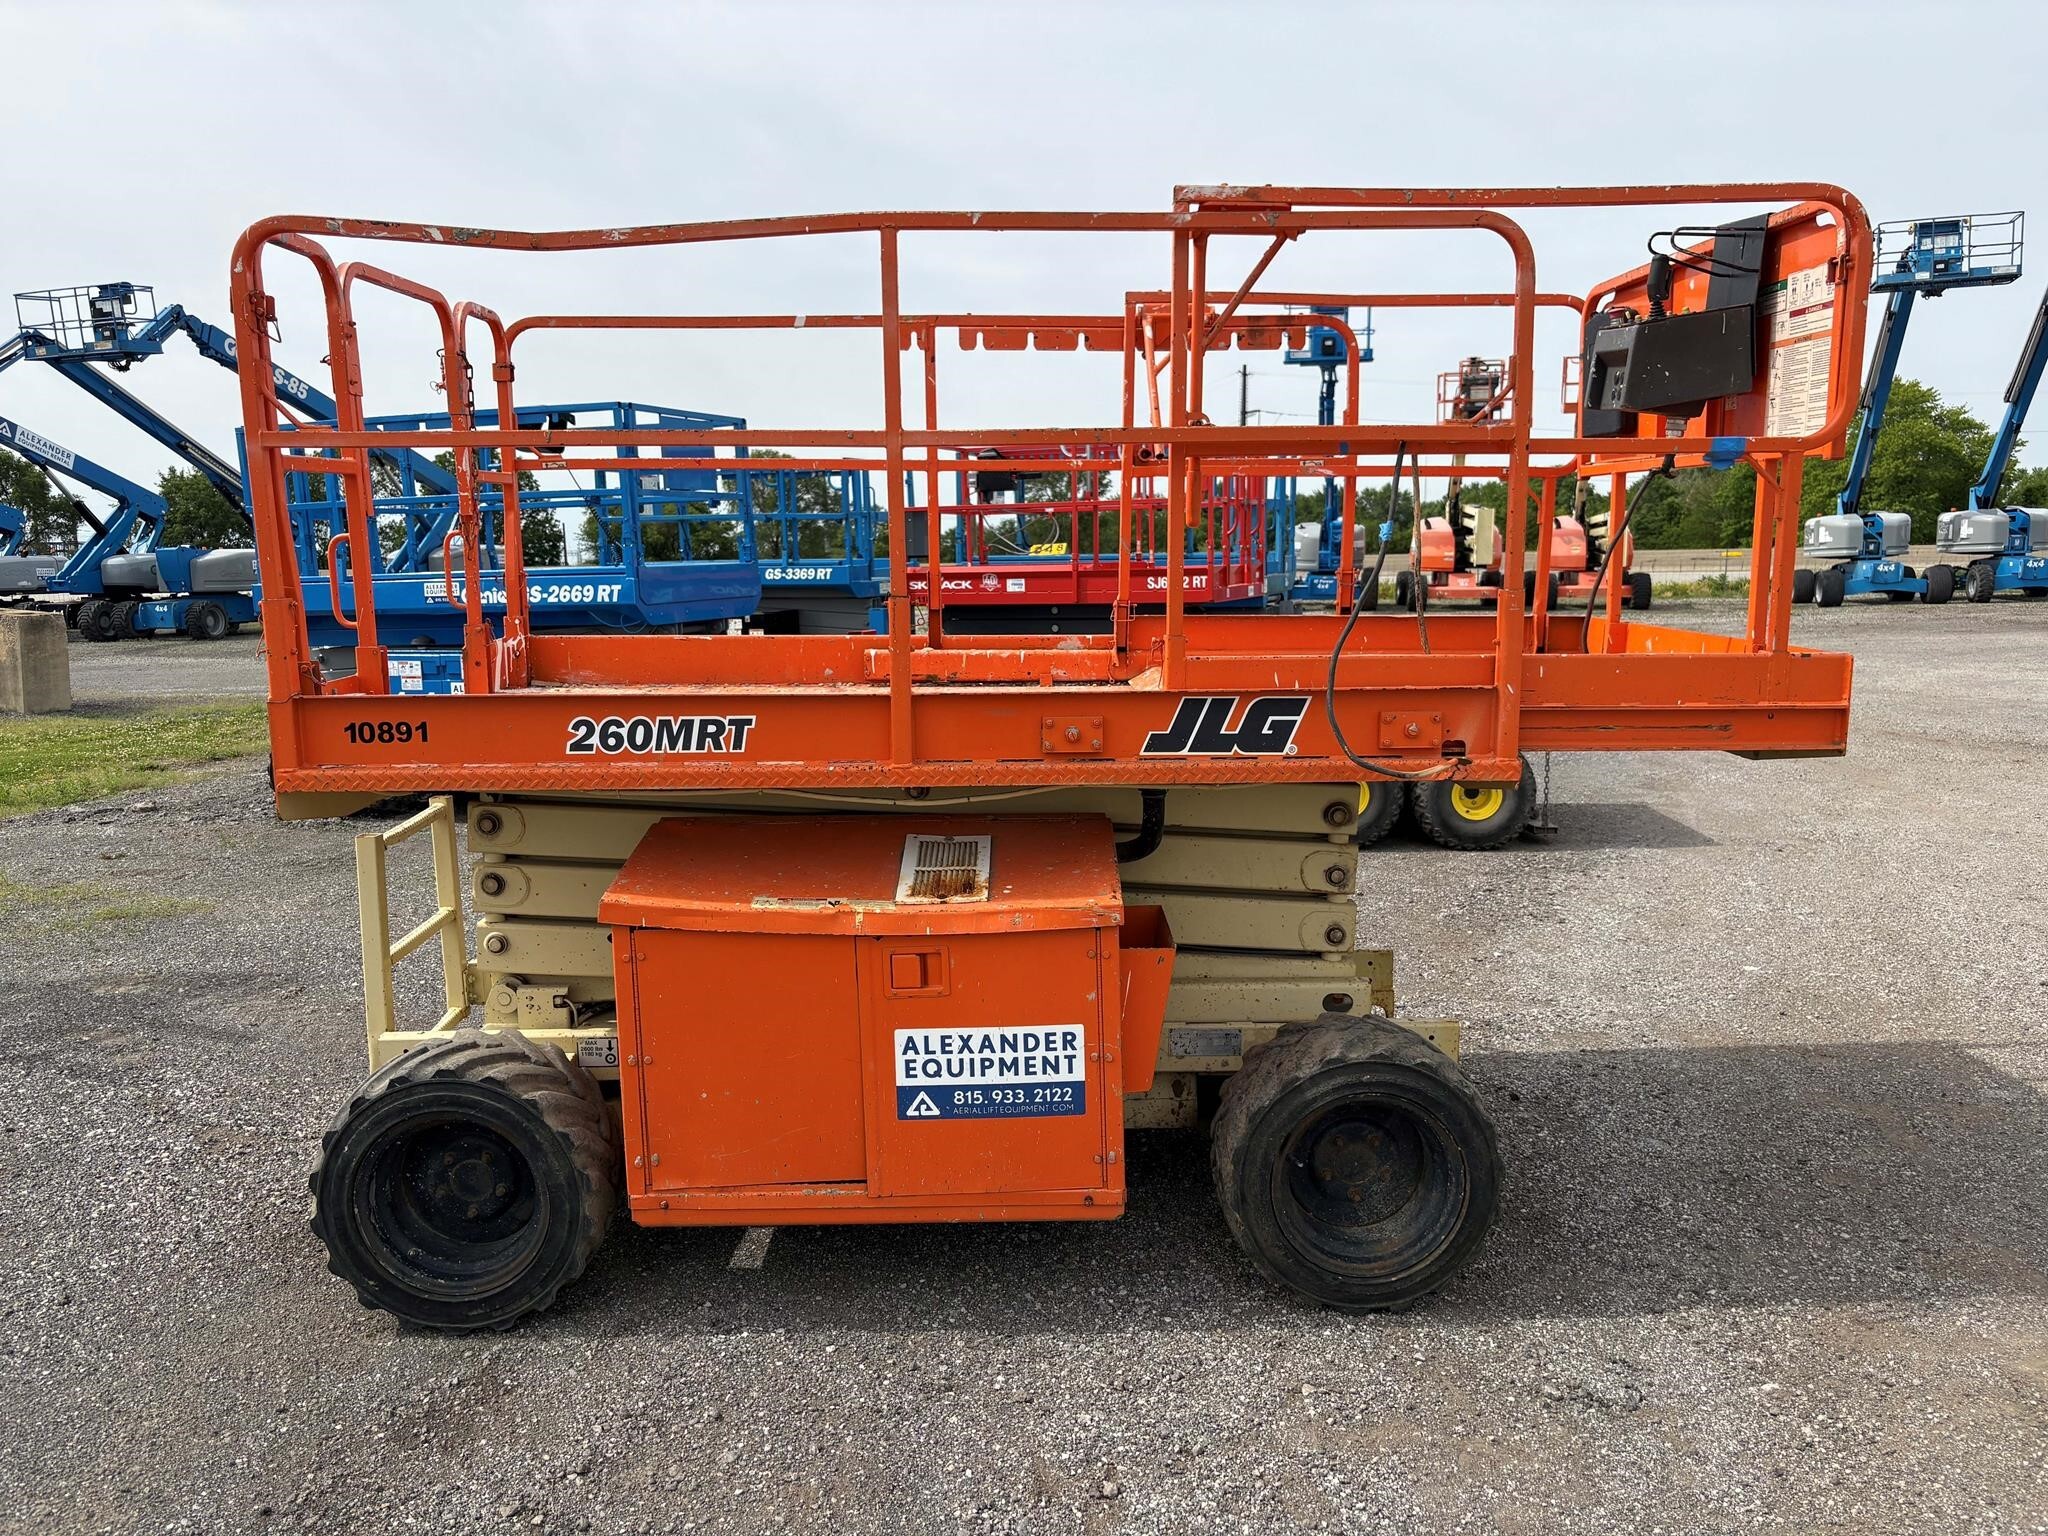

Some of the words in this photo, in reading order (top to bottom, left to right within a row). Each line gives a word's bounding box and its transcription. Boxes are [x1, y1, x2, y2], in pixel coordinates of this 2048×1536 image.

[18, 437, 50, 456] EQUIPMENT
[50, 452, 71, 466] RENTAL
[19, 430, 72, 460] ALEXANDER
[765, 568, 815, 580] GS-3369
[816, 568, 833, 580] RT
[2026, 560, 2045, 568] 4x4
[461, 587, 508, 604] nie
[597, 584, 622, 603] RT
[909, 580, 973, 590] SKACK
[1147, 576, 1189, 589] SJ62
[1192, 576, 1208, 588] RT
[155, 604, 168, 612] 4x4
[344, 721, 429, 744] 10891
[566, 715, 756, 754] 260MRT
[1139, 696, 1312, 755] JLG
[902, 1031, 1078, 1055] ALEXANDER
[904, 1054, 1077, 1079] EQUIPMENT
